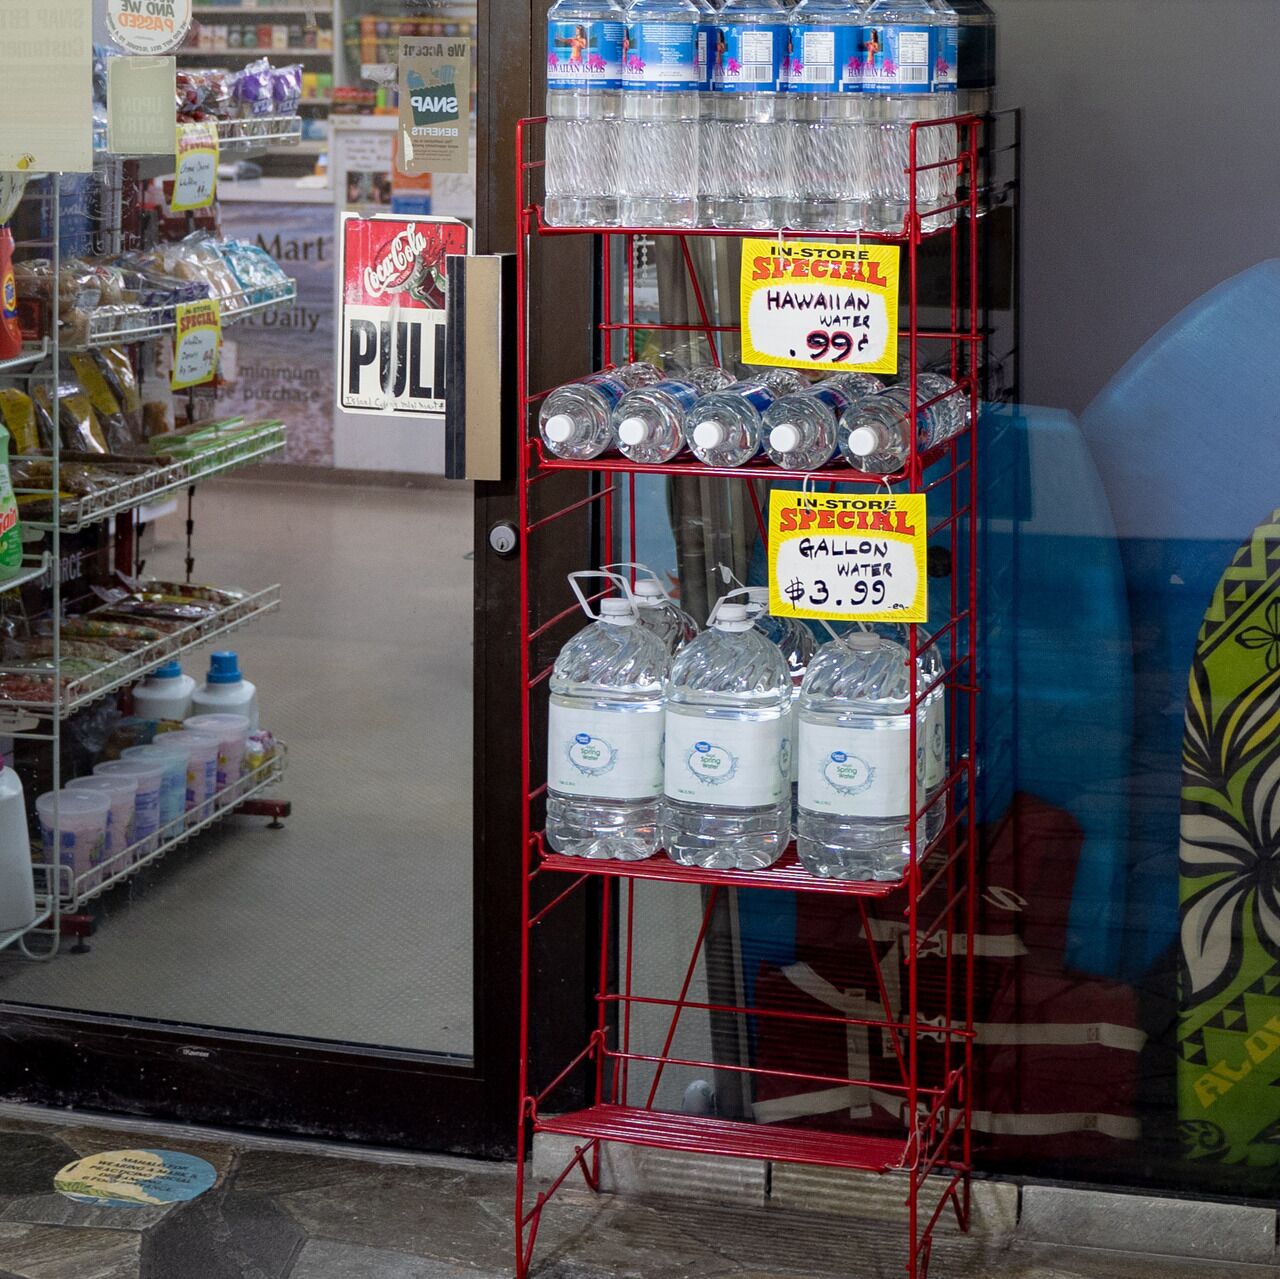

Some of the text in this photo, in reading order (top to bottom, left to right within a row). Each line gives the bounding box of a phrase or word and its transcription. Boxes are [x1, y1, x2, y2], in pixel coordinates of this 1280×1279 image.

[256, 233, 326, 262] Mart
[770, 246, 870, 260] IN-STORE
[363, 222, 427, 298] Coca-Cola
[752, 256, 887, 287] SPECIAL
[767, 289, 870, 311] HAWAIIAN
[263, 305, 321, 333] Daily
[819, 314, 870, 329] WATER
[239, 365, 320, 383] minimum
[243, 384, 320, 407] purchase
[796, 497, 897, 510] IN-STORE
[779, 507, 915, 536] SPECIAL
[799, 537, 888, 560] GALLON
[837, 562, 893, 578] WATER
[784, 576, 886, 610] $3.99
[580, 748, 601, 758] Spring
[700, 756, 721, 766] Spring
[836, 766, 857, 776] Spring
